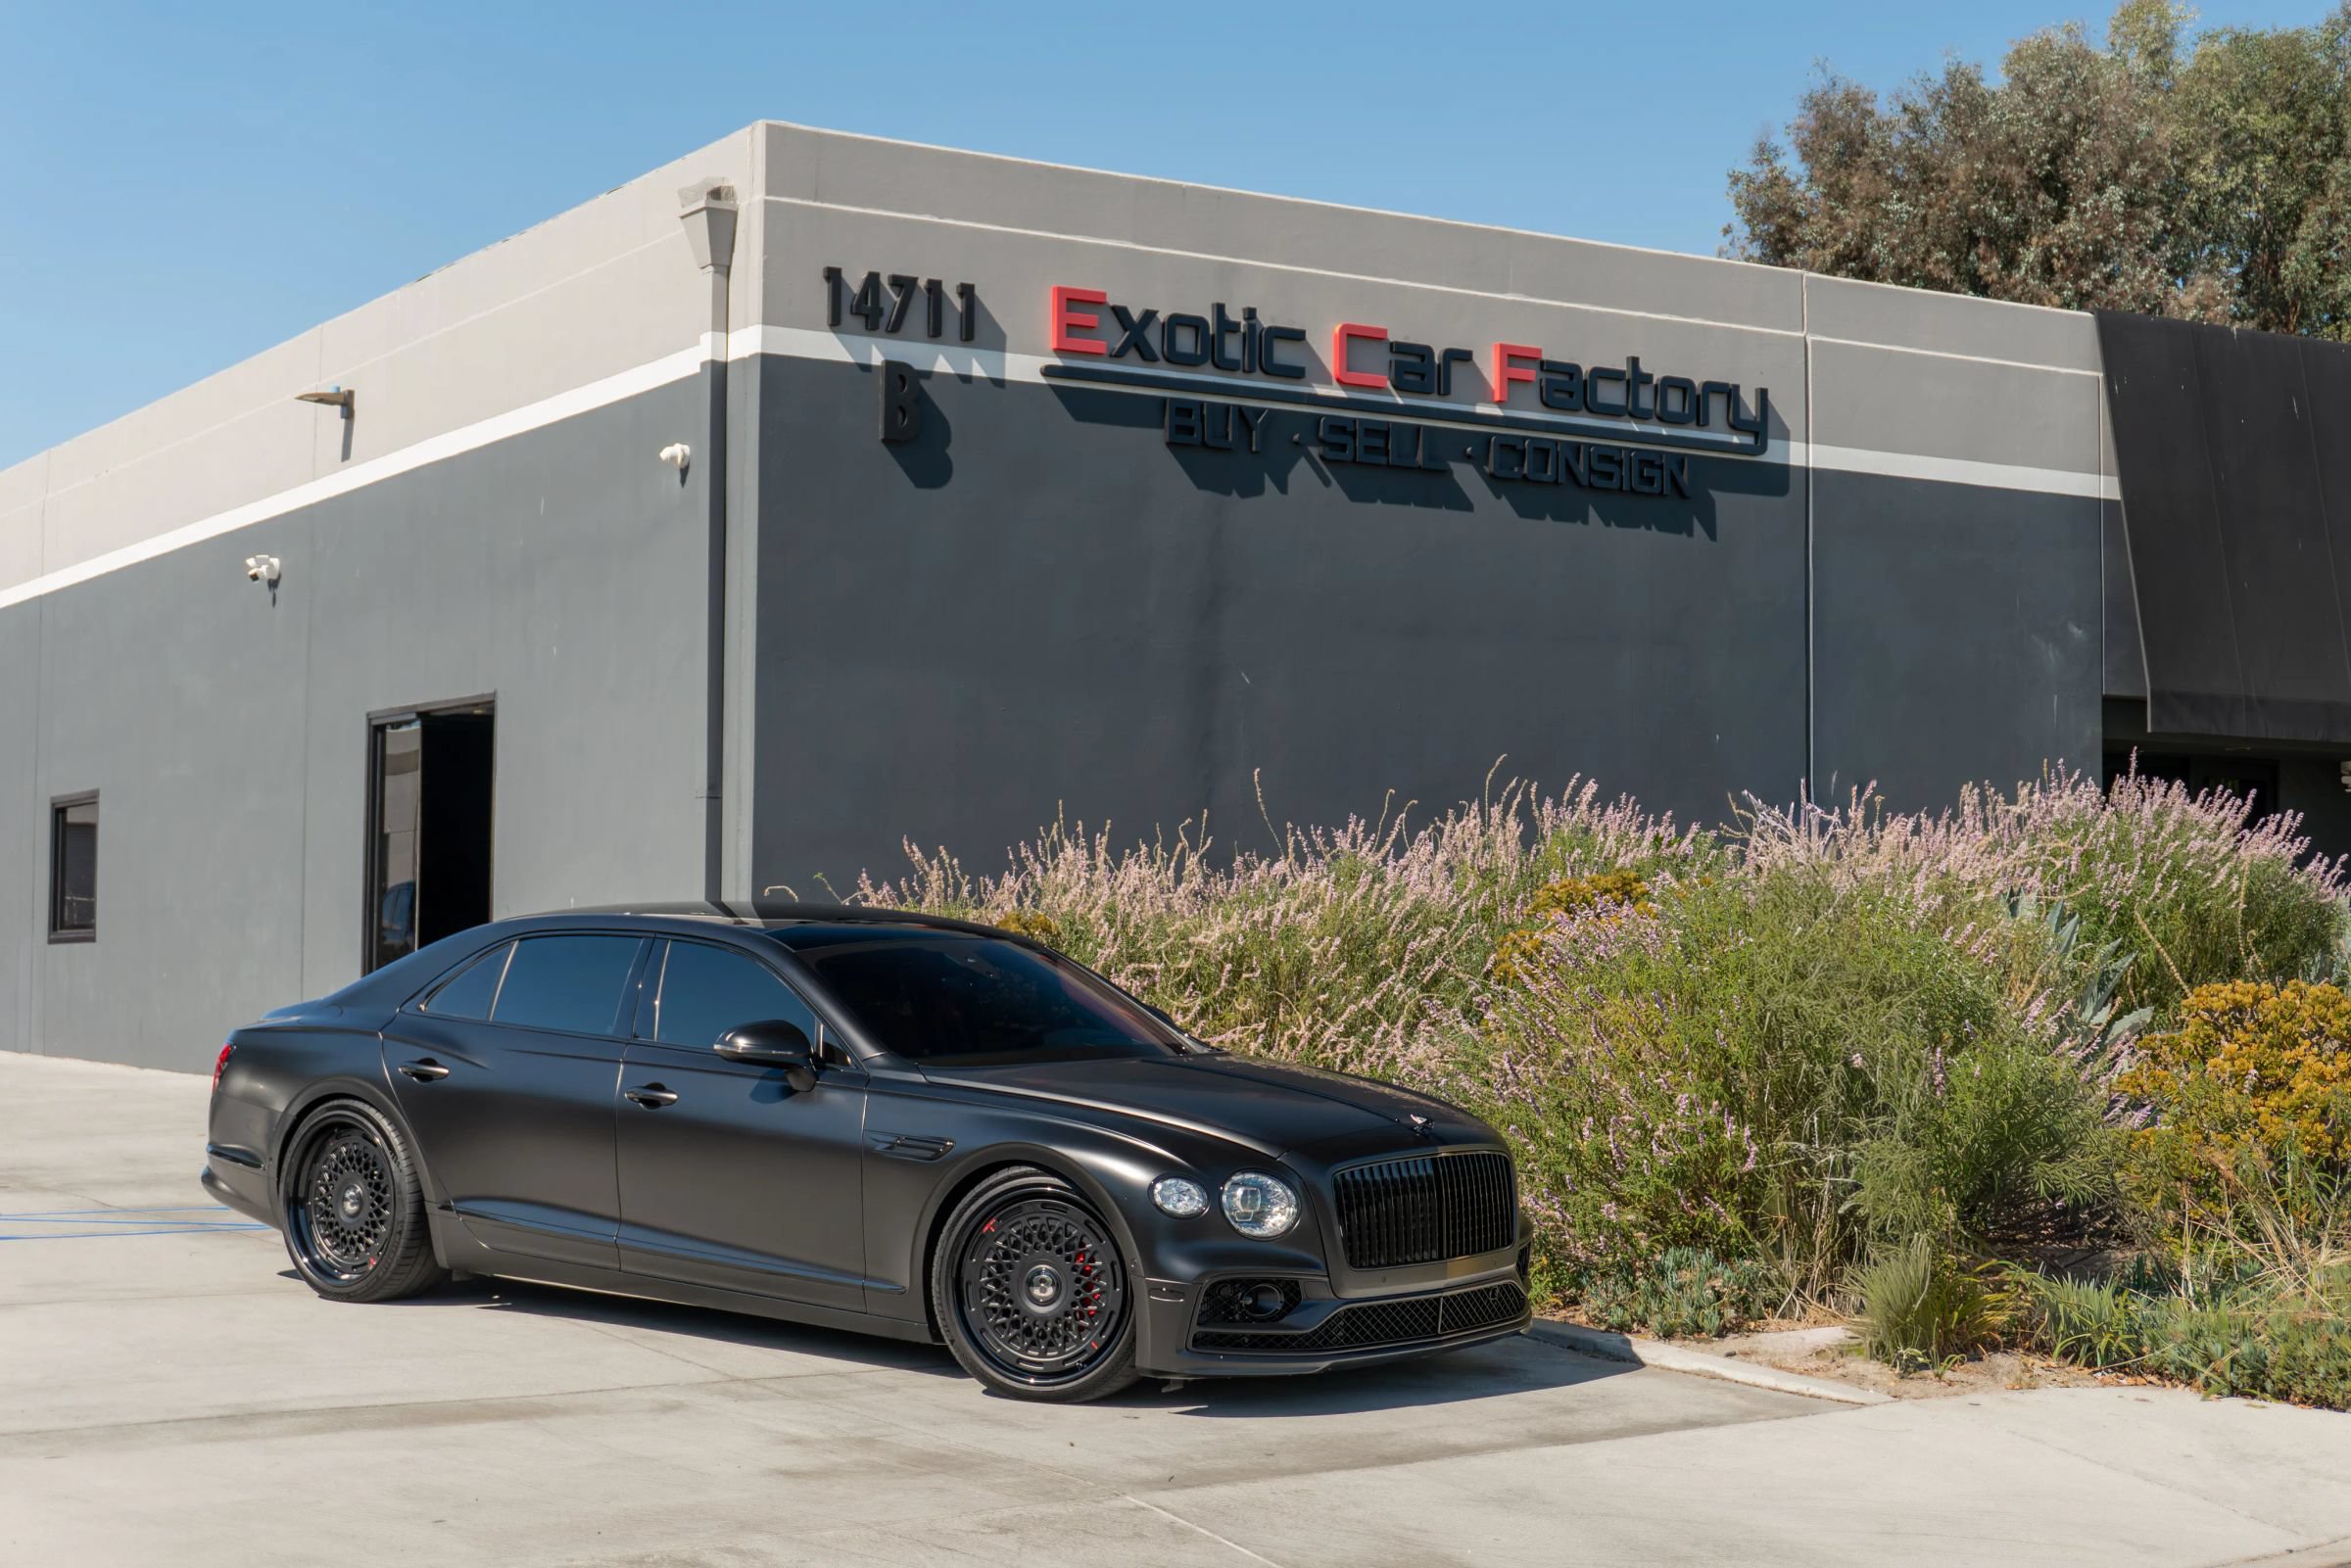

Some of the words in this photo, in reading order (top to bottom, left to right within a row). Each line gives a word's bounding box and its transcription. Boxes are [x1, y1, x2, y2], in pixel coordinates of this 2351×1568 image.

[823, 266, 976, 342] 14711
[881, 359, 920, 442] B
[1052, 285, 1306, 380] Exotic
[1333, 323, 1473, 396] Car
[1493, 342, 1769, 455] Factory
[1164, 396, 1270, 452] BUY
[1318, 413, 1450, 470] SELL
[1488, 435, 1691, 498] CONSIGN
